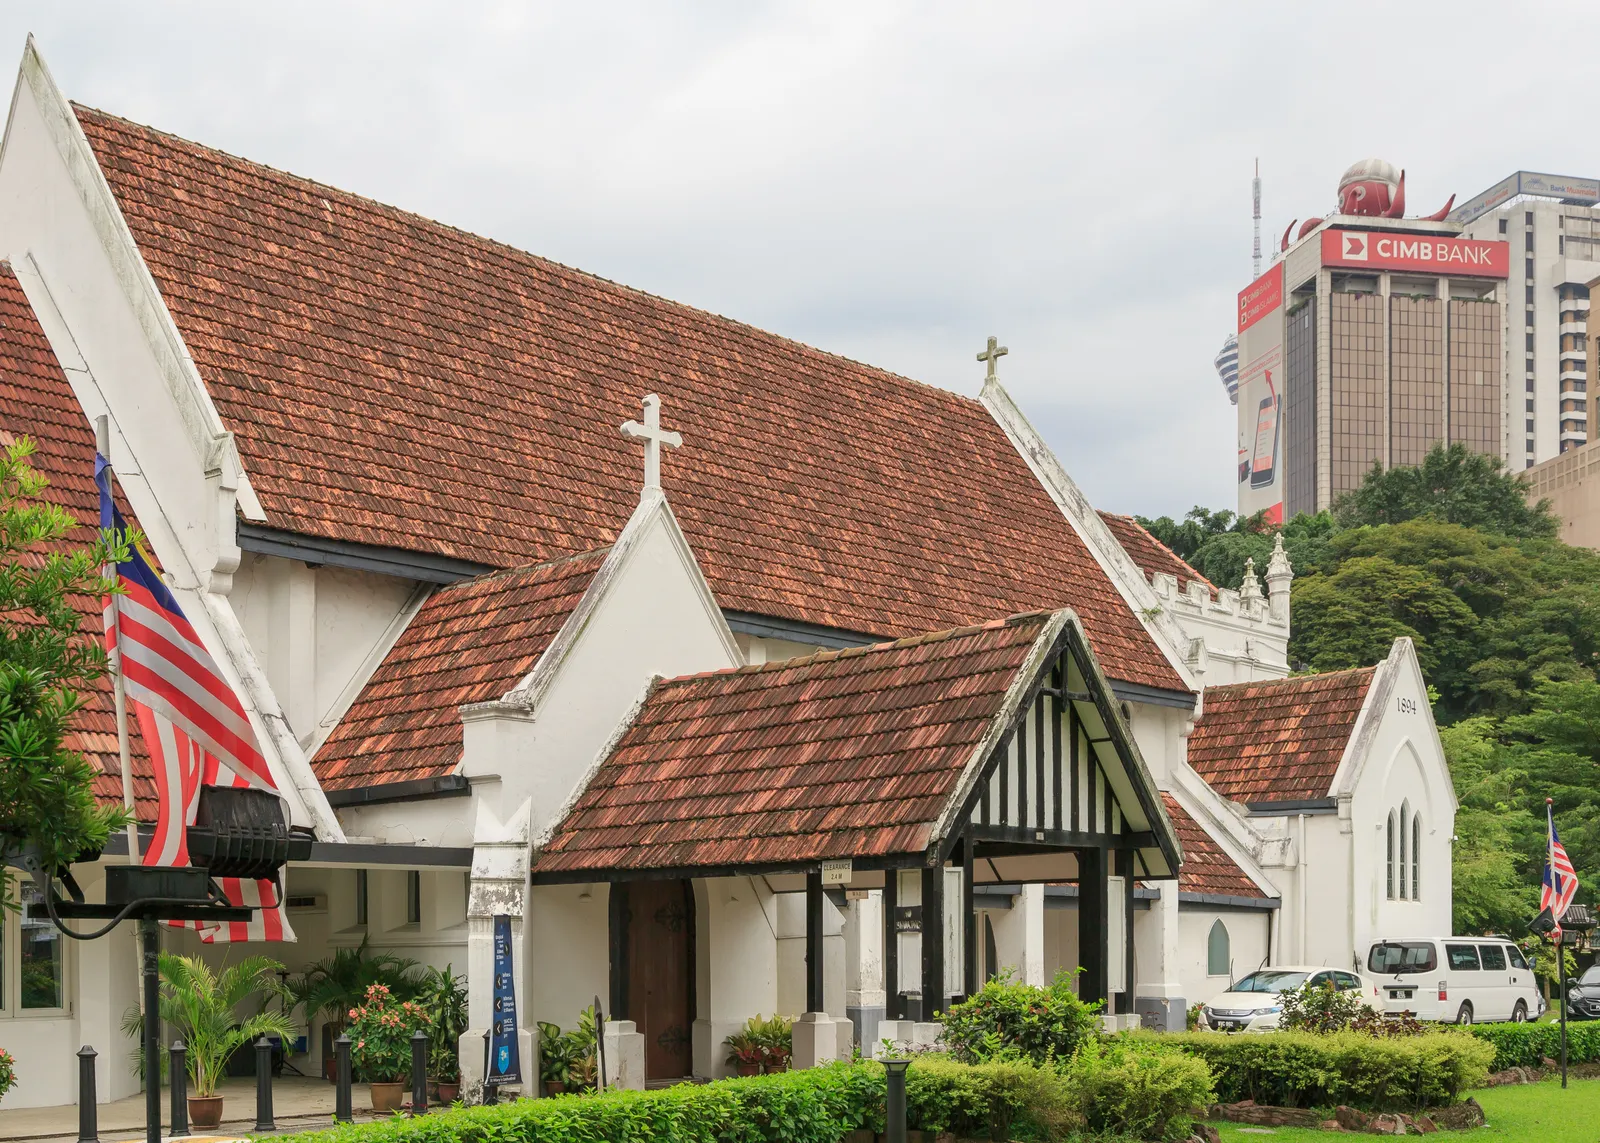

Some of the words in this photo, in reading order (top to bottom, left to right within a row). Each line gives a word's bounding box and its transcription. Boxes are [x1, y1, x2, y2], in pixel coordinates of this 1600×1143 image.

[1376, 239, 1433, 260] CIMB
[1436, 243, 1492, 265] BANK
[1397, 697, 1416, 715] 1894
[823, 863, 851, 871] CLEARANCE
